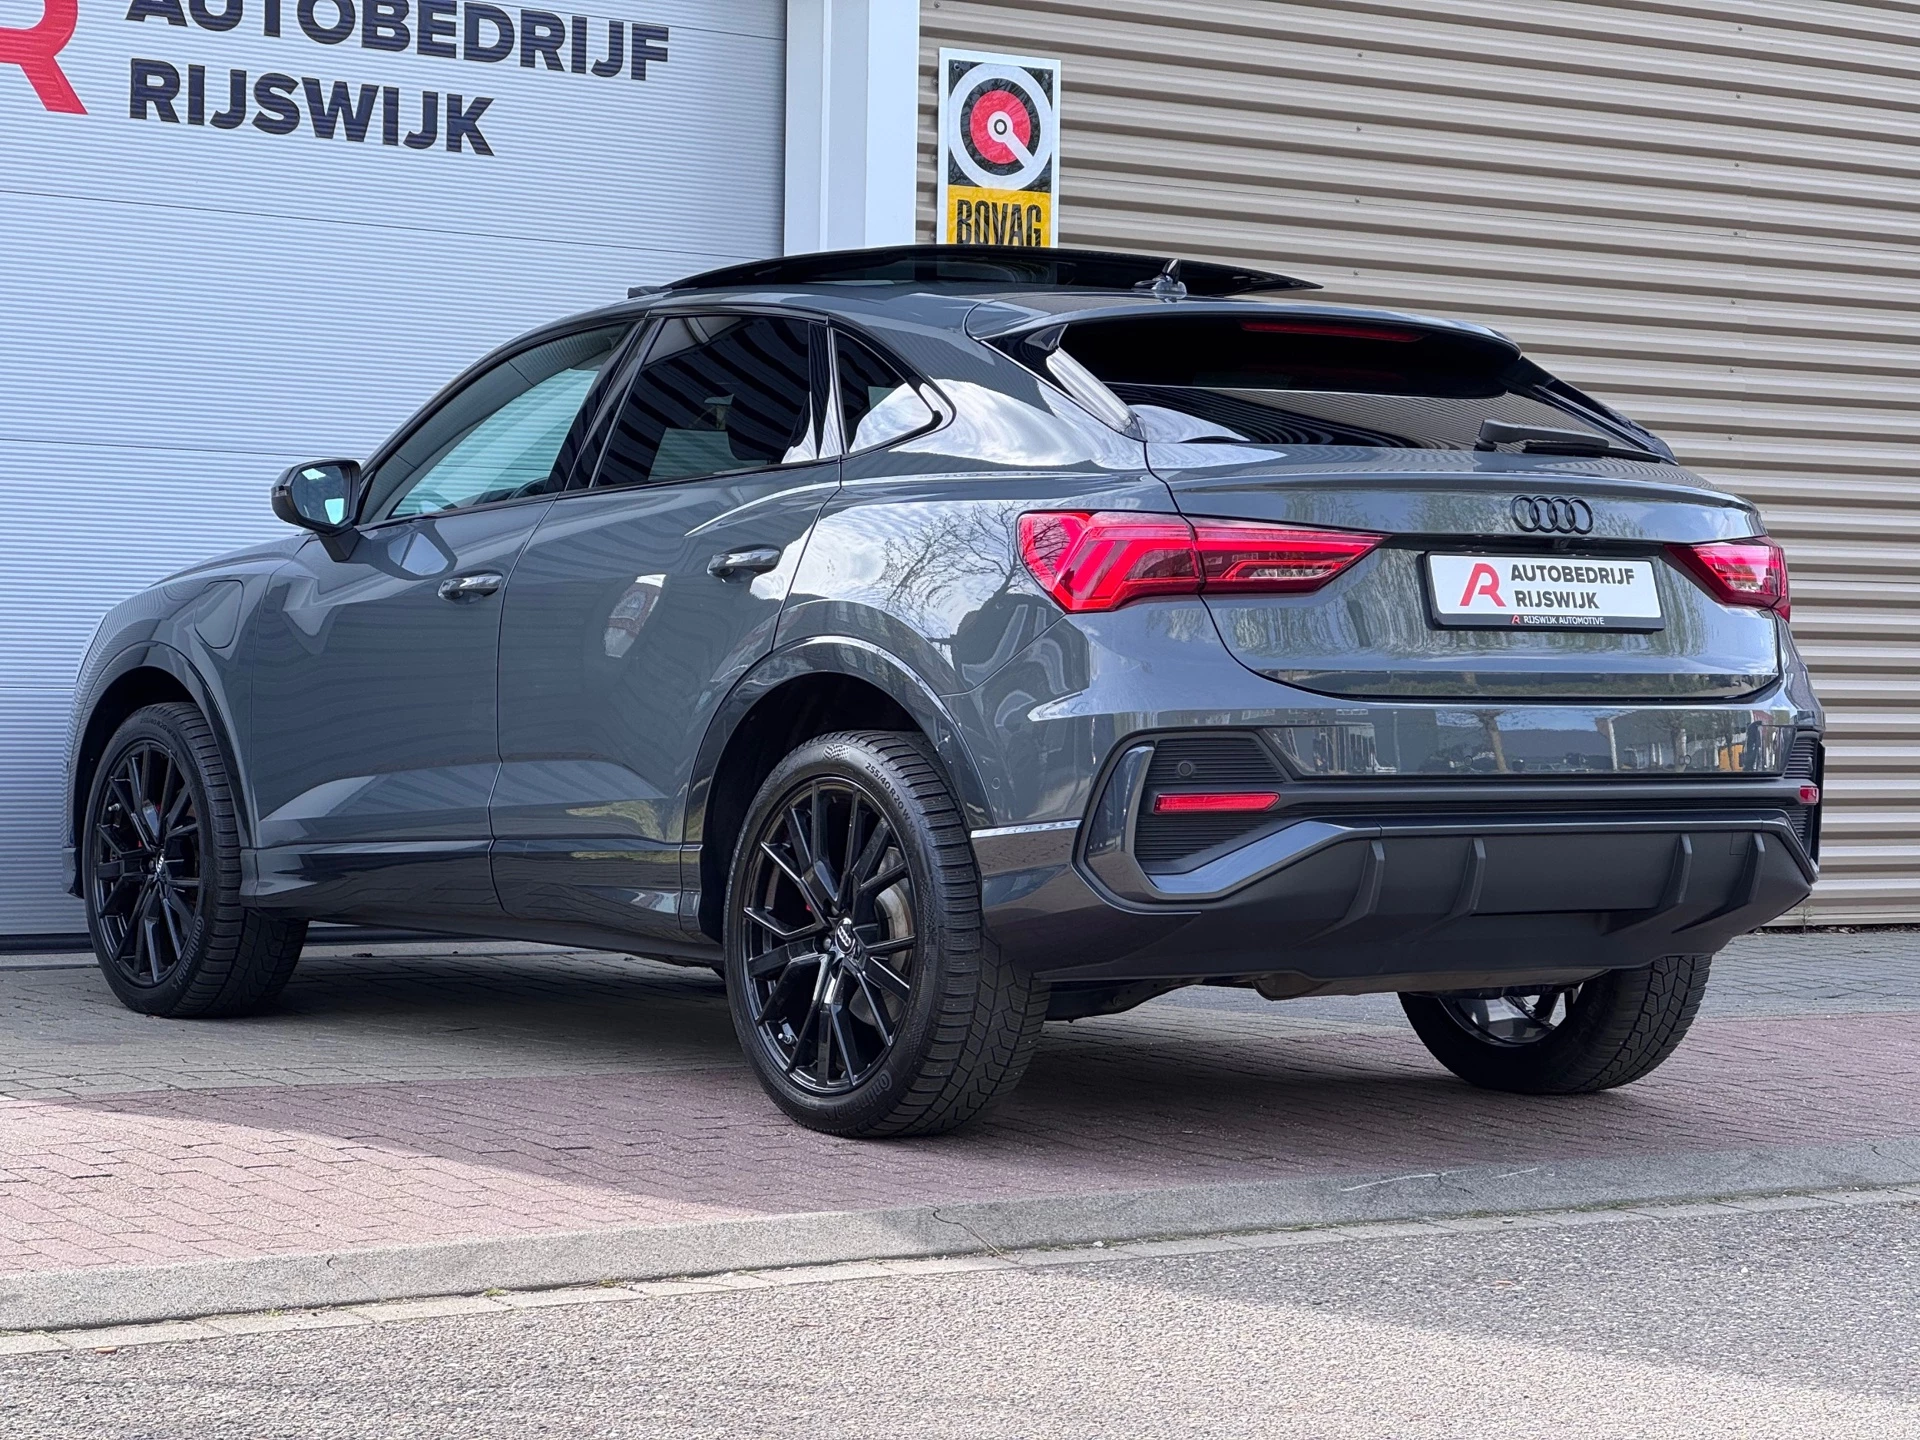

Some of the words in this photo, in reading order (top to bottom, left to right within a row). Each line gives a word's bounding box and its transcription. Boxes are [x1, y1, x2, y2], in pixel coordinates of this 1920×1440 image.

[130, 58, 496, 157] RIJSWIJK
[956, 199, 1042, 248] BOVAG
[1510, 564, 1635, 585] AUTOBEDRIJF
[1514, 590, 1600, 609] RIJSWIJK
[1523, 615, 1557, 625] RIJSWIJK
[1559, 616, 1605, 625] AUTOMOTIVE
[865, 762, 891, 790] 255/40
[889, 787, 904, 809] R20
[174, 915, 205, 985] Continental
